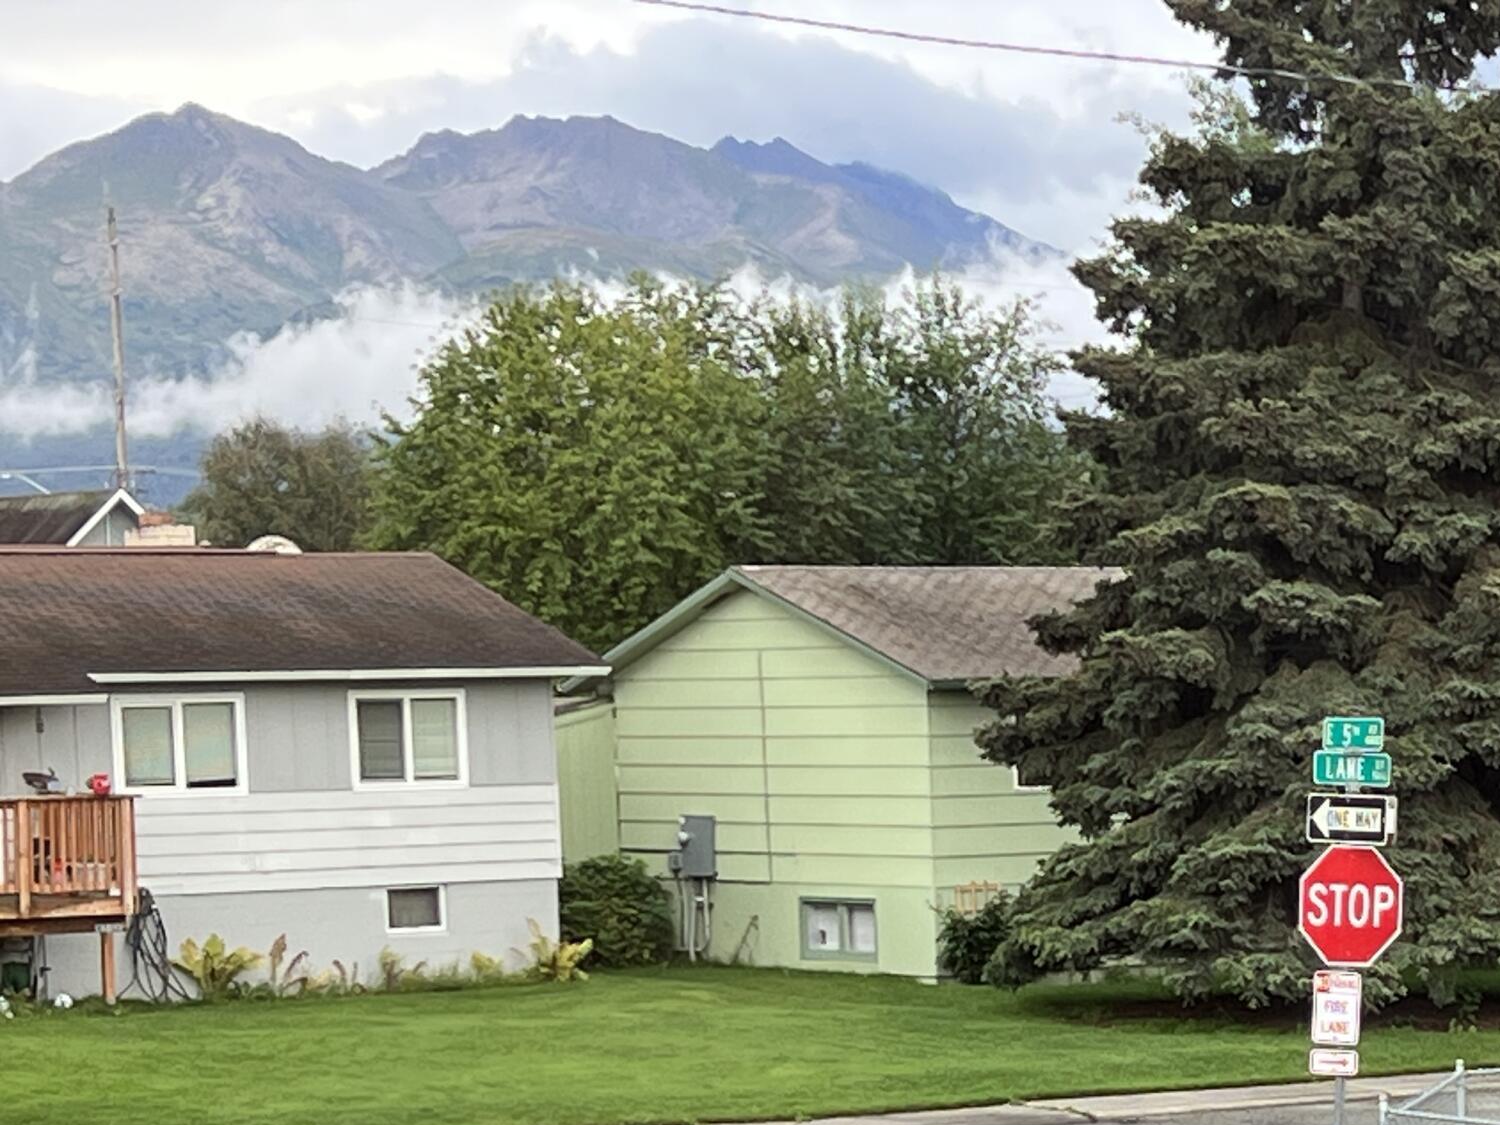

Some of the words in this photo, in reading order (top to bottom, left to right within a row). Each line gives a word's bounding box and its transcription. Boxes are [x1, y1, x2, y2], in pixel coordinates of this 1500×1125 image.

[1325, 755, 1365, 781] LANE
[1327, 809, 1350, 828] ONE
[1355, 810, 1379, 829] WAY
[1307, 882, 1395, 929] STOP
